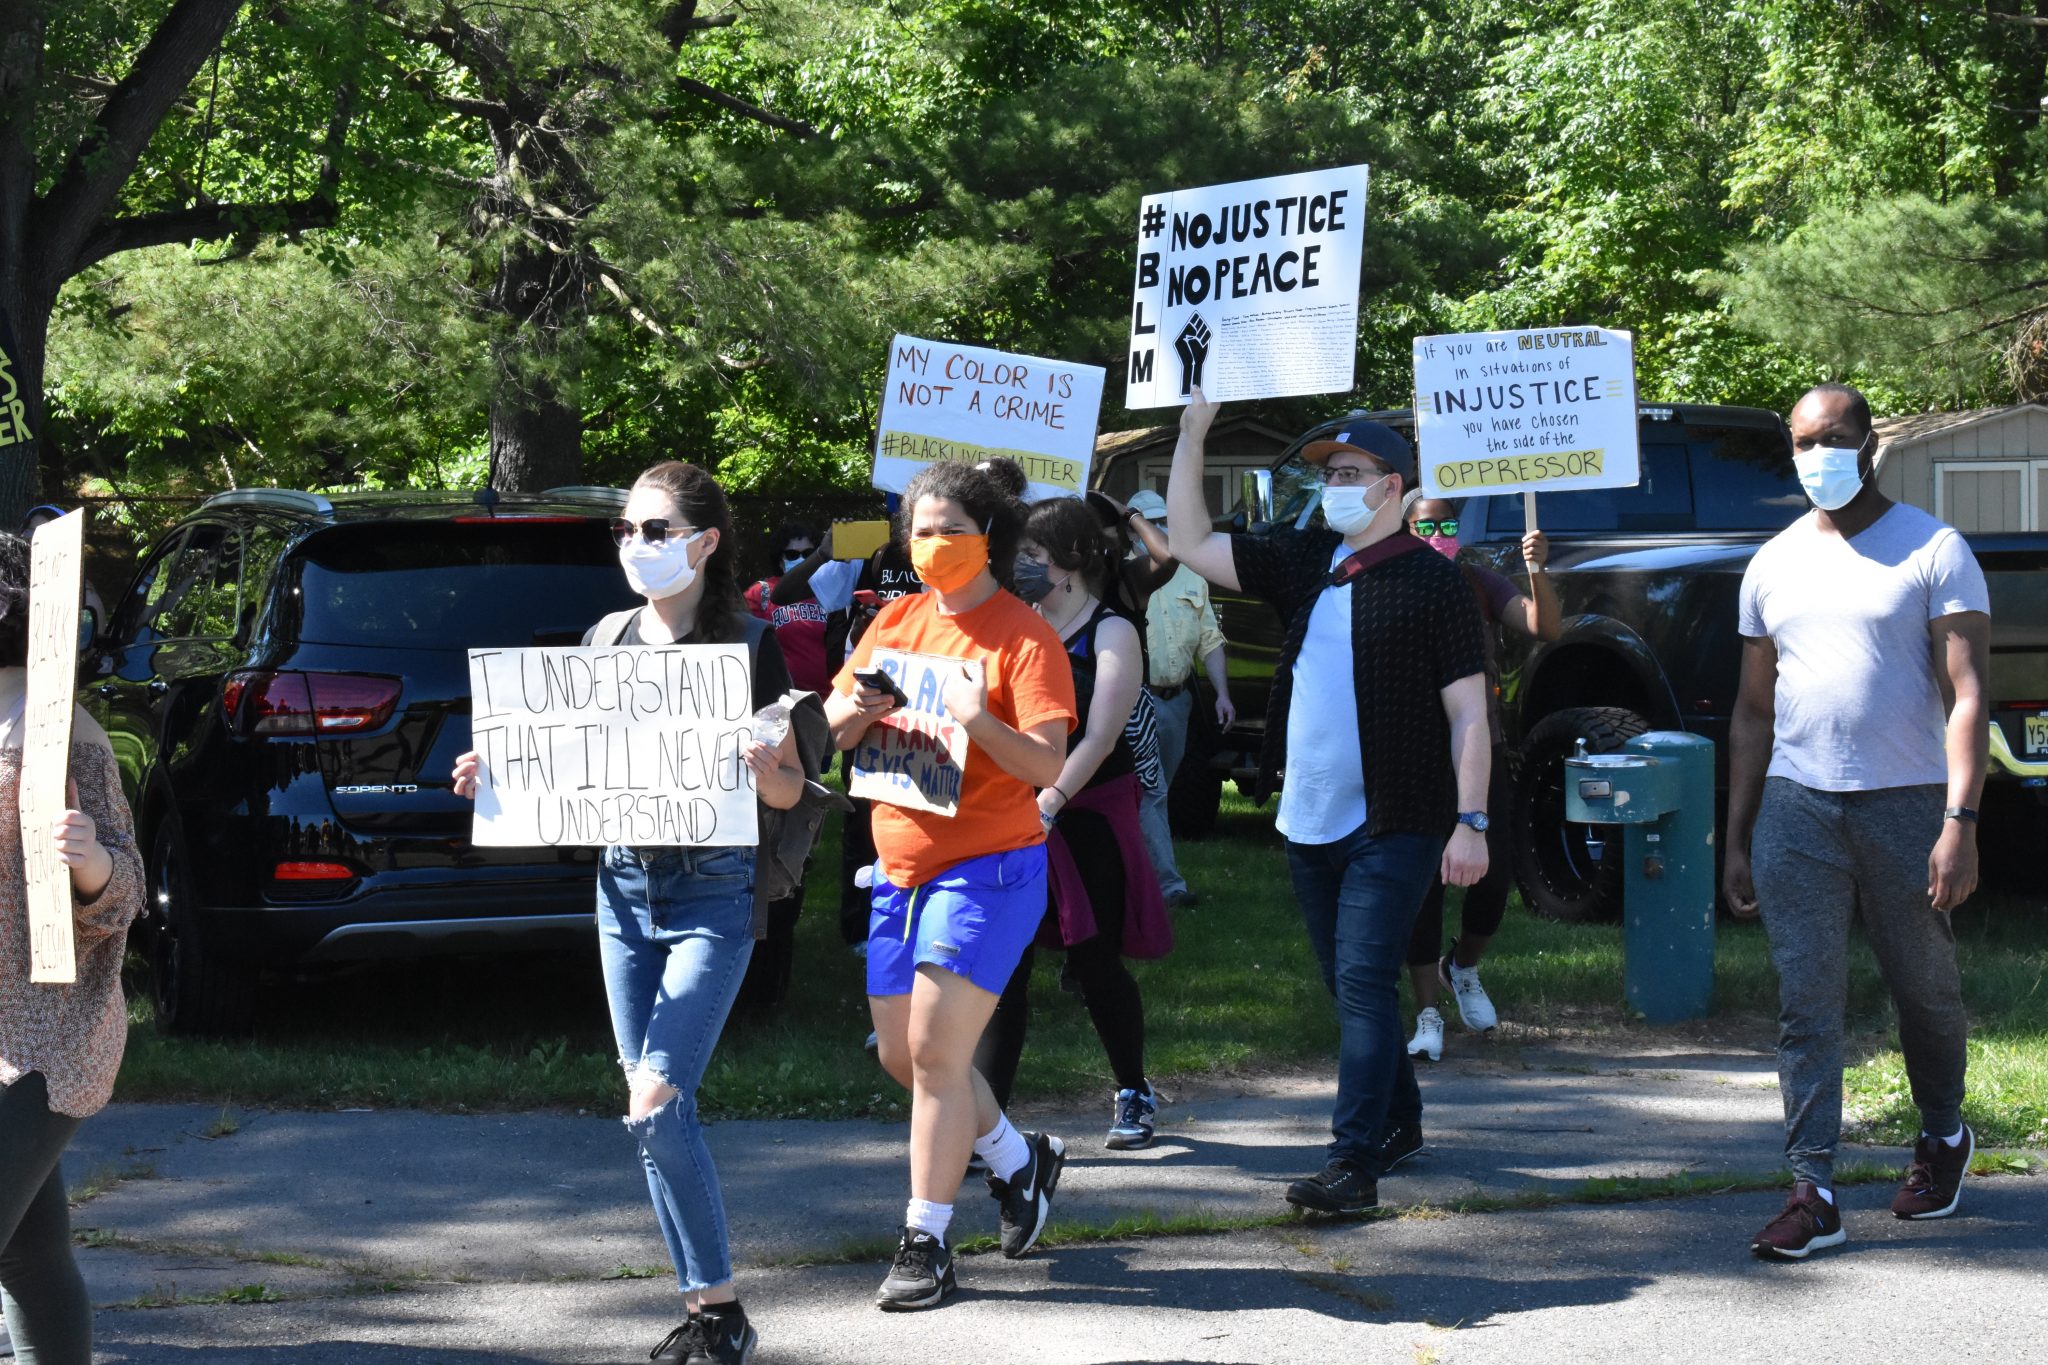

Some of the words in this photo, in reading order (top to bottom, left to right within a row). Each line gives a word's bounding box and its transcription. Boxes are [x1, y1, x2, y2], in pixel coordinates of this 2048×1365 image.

[1171, 211, 1212, 252] NO
[1212, 190, 1348, 244] JUSTICE
[1167, 265, 1211, 307] NO
[1214, 245, 1321, 301] PEACE
[1446, 342, 1472, 361] you
[1486, 340, 1508, 354] are
[1518, 330, 1607, 351] NEUTRAL
[1480, 359, 1552, 378] situations
[1558, 356, 1571, 370] of
[897, 346, 930, 376] MY
[945, 354, 1029, 390] COLOR
[1048, 373, 1074, 399] IS
[1433, 376, 1601, 415] INJUSTICE
[899, 381, 954, 406] NOT
[967, 390, 982, 415] A
[994, 395, 1065, 430] CRIME
[1462, 420, 1483, 438] you
[1491, 417, 1522, 432] have
[1486, 438, 1508, 453] the
[1513, 435, 1535, 449] side
[1540, 433, 1551, 446] of
[1552, 432, 1575, 446] the
[1438, 451, 1602, 488] OPPRESSOR
[772, 603, 828, 630] RUTGER
[470, 651, 512, 721] I
[520, 650, 750, 722] UNDERSTAND
[472, 724, 566, 794] THAT
[575, 724, 649, 791] I'LL
[658, 727, 755, 792] NEVER
[874, 715, 955, 765] TRANS
[336, 784, 418, 794] SORENTO
[854, 747, 915, 790] LIVES
[920, 762, 961, 803] MATTER
[537, 794, 717, 845] UNDERSTAND
